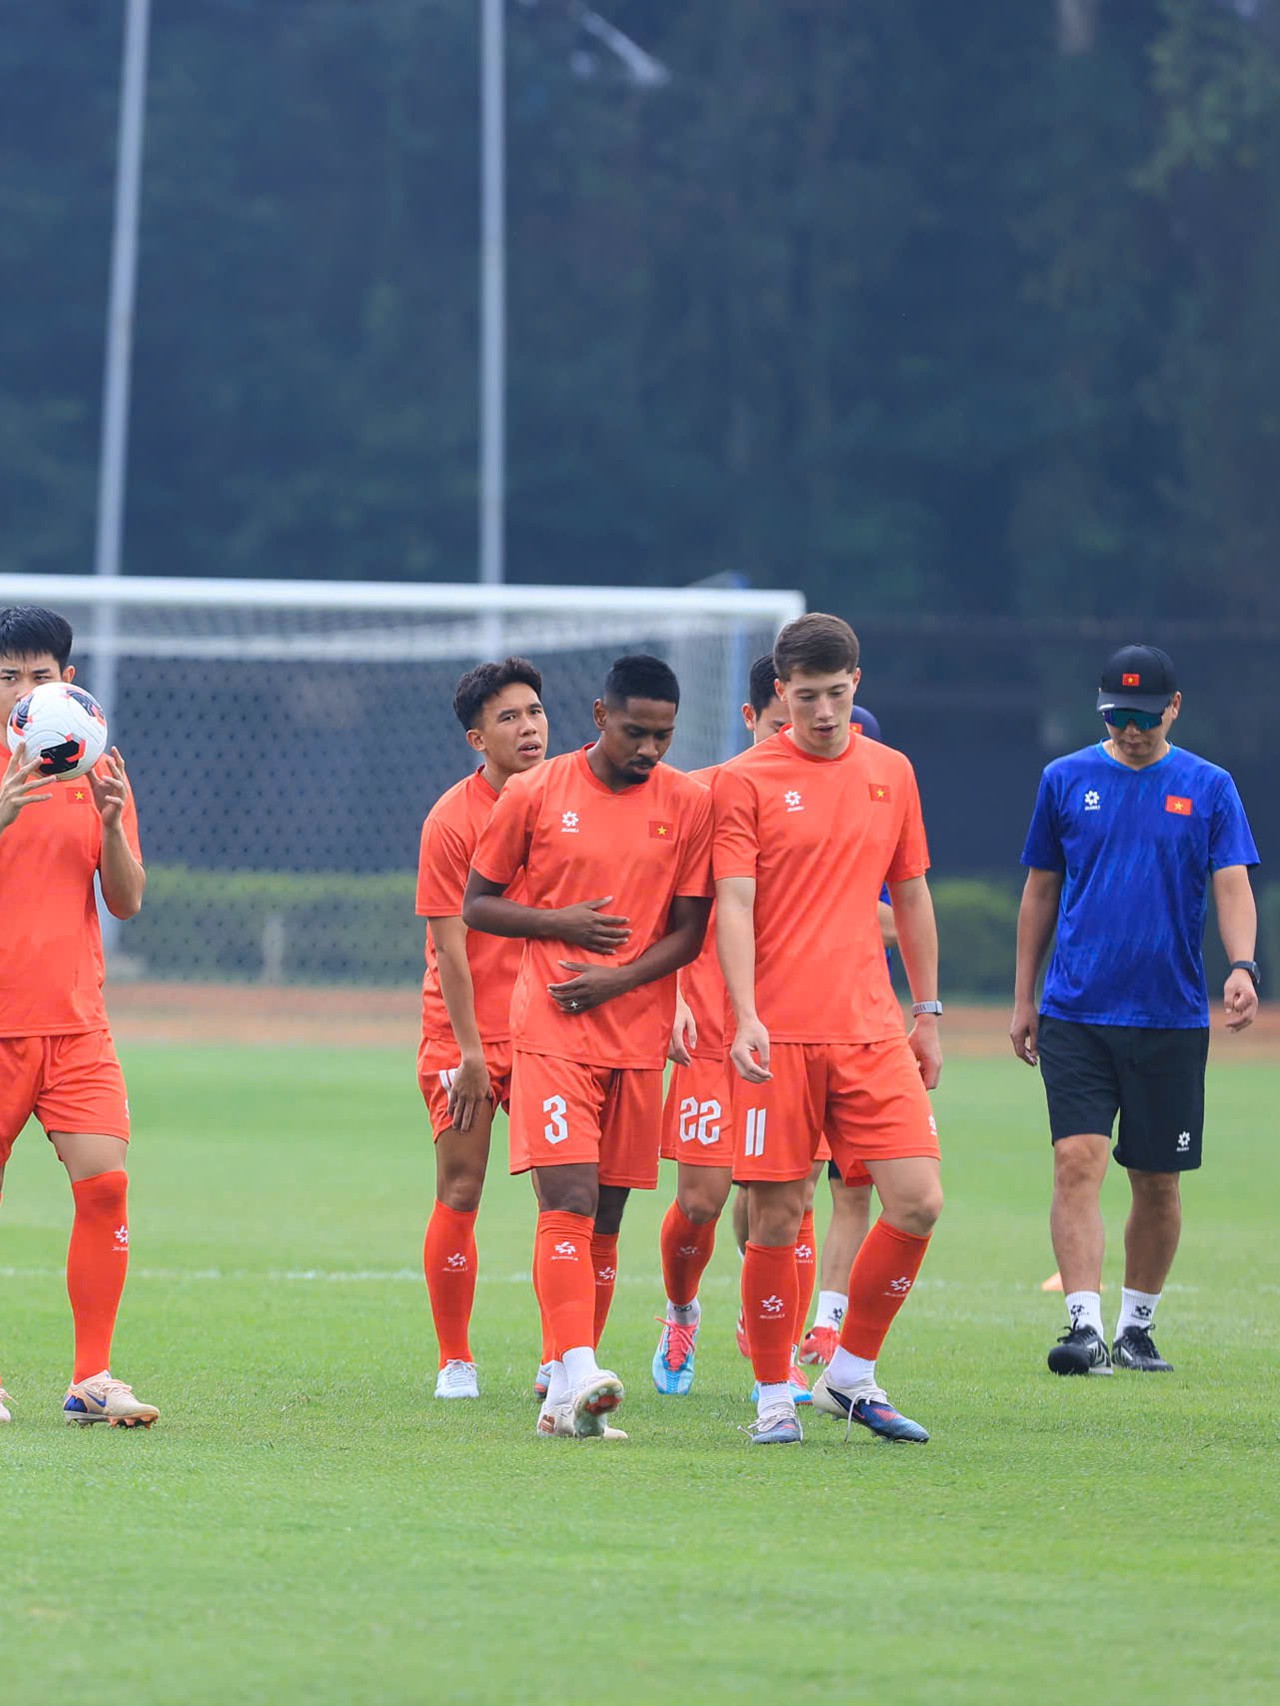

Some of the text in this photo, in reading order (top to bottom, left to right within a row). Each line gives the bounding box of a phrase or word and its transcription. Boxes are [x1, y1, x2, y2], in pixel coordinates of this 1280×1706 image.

[542, 1094, 569, 1145] 3
[679, 1096, 722, 1145] 22
[744, 1107, 767, 1157] 11
